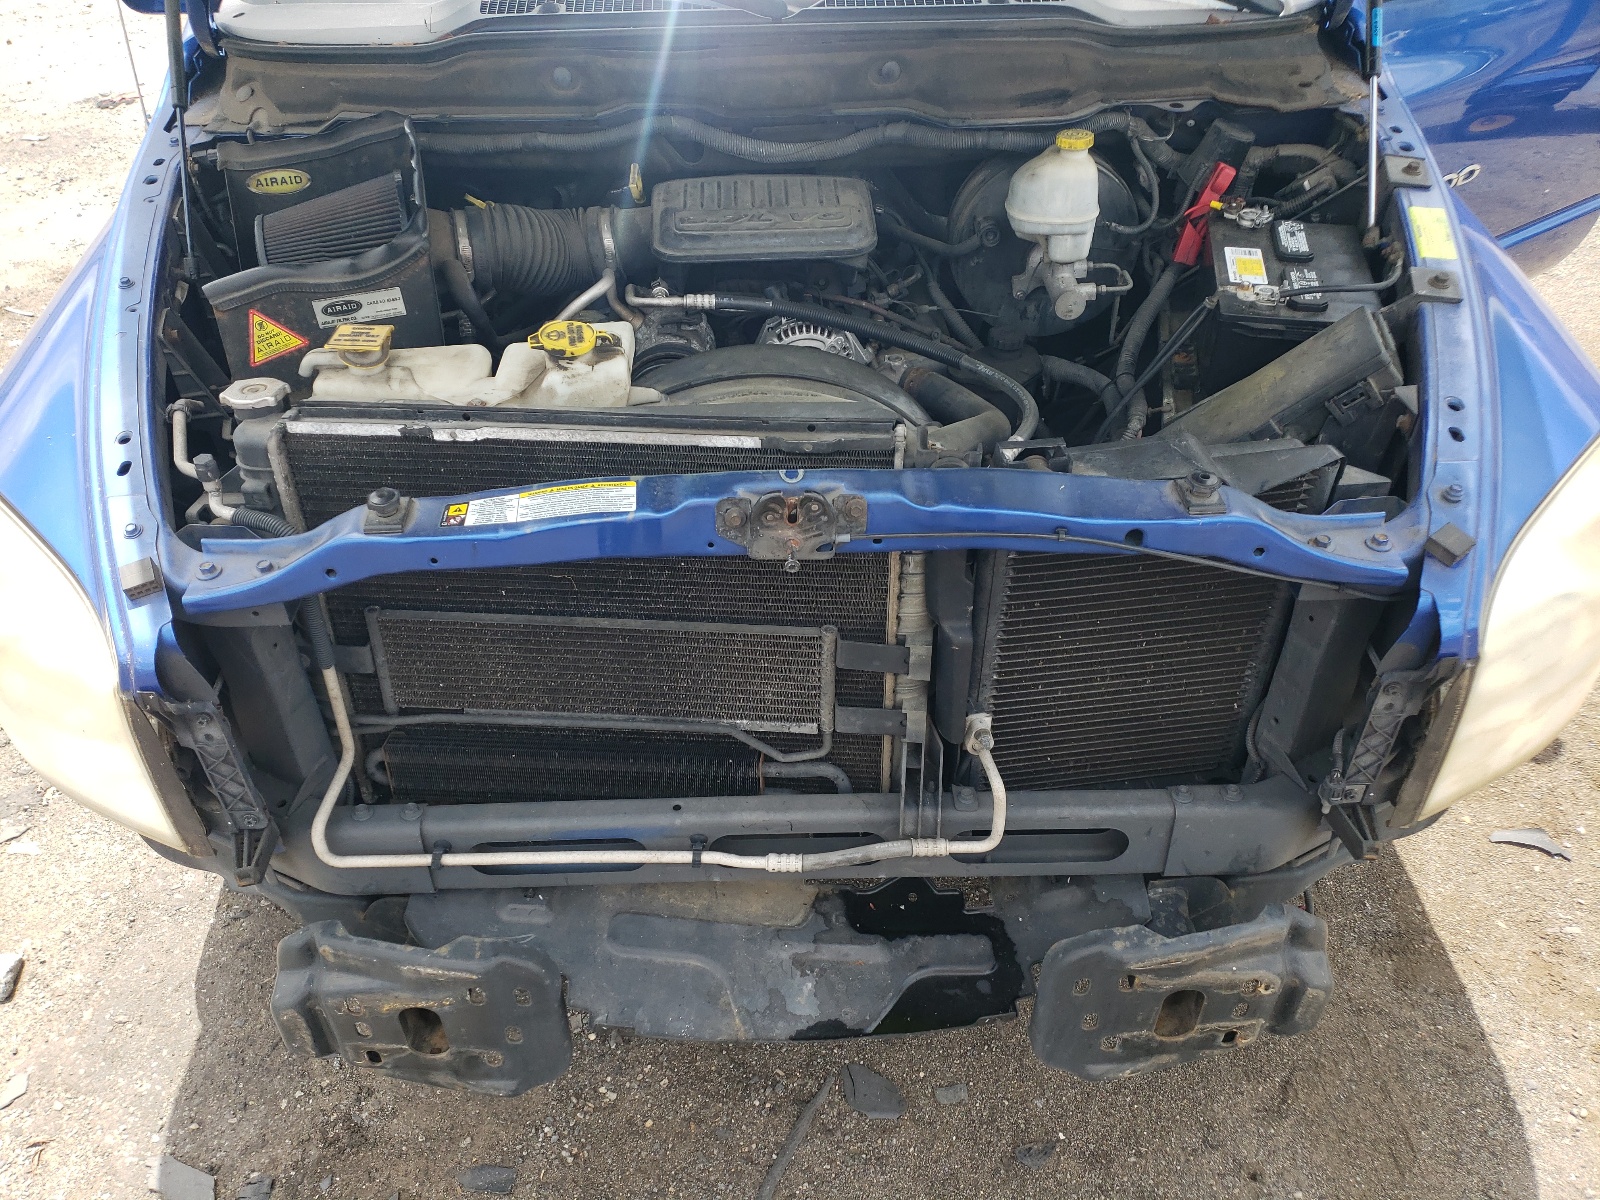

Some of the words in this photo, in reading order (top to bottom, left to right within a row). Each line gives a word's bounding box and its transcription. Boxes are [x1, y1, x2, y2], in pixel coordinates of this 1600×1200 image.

[255, 175, 303, 188] AIRAID
[327, 303, 357, 314] AIRAID
[257, 335, 292, 353] AIRAID
